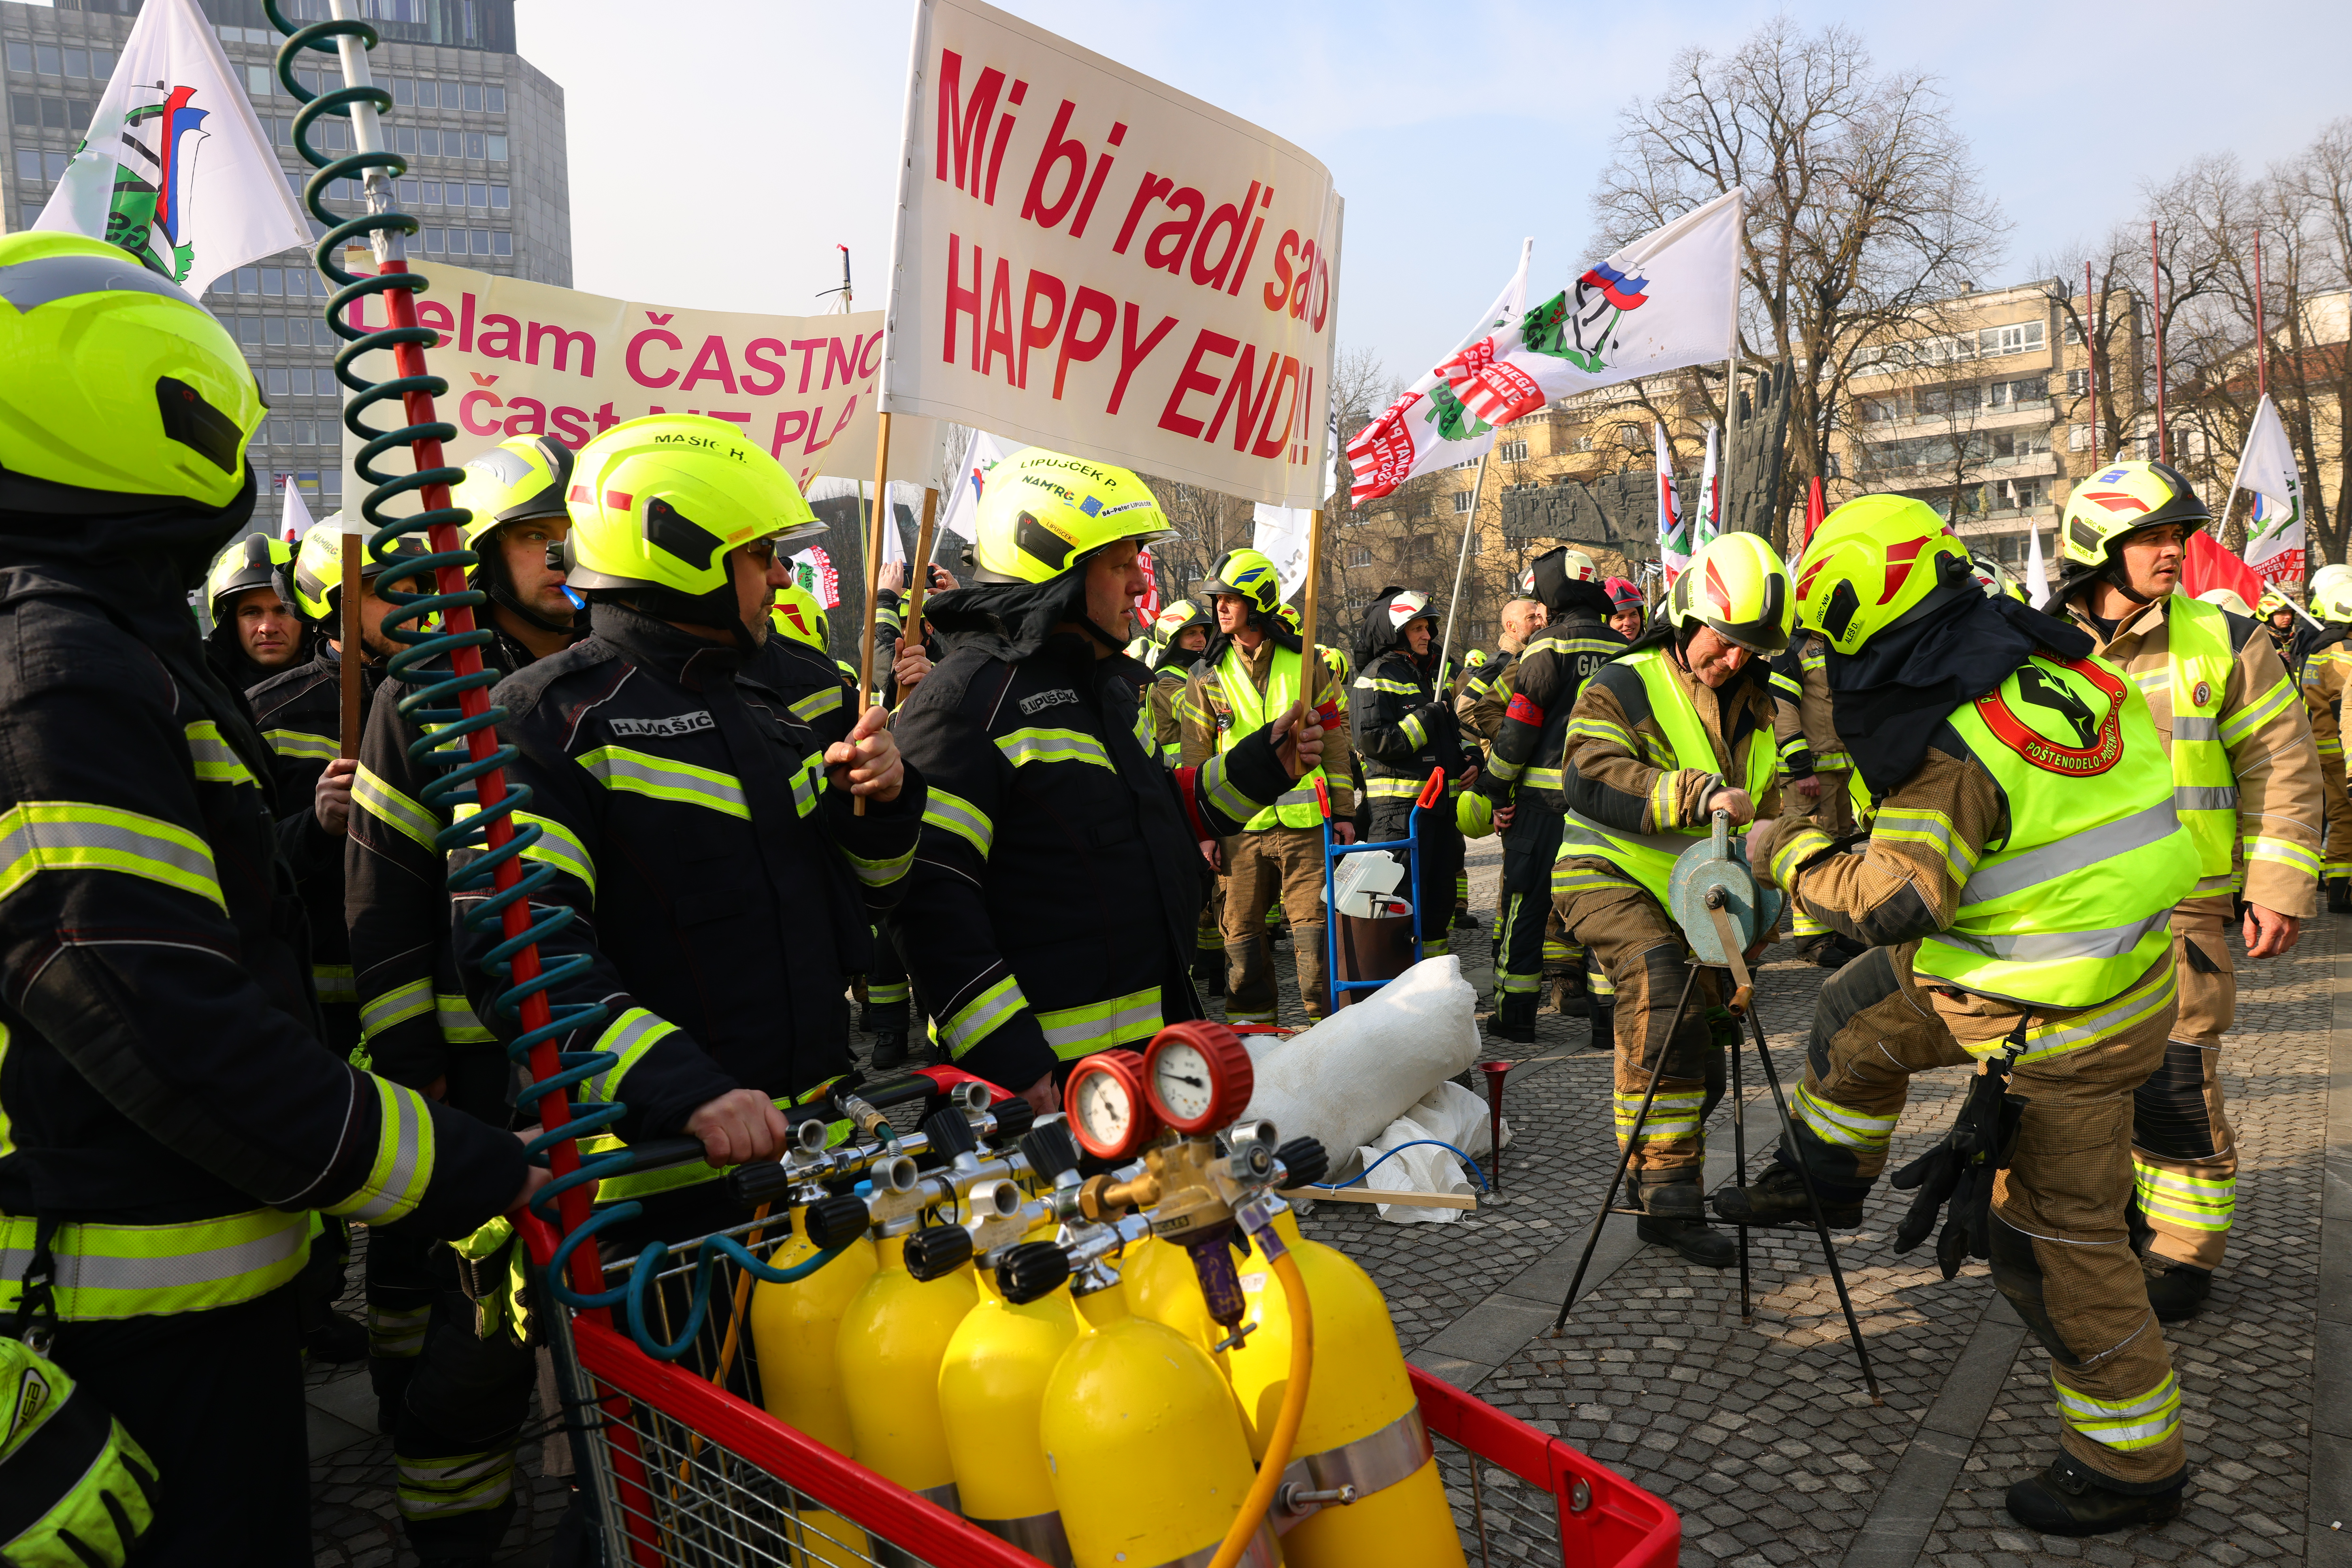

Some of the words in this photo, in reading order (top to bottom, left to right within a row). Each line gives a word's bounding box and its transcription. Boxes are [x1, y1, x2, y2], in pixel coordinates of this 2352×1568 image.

[936, 48, 1028, 206] Mi
[1020, 99, 1128, 239] bi
[1112, 179, 1274, 297] radi
[943, 233, 1179, 415] HAPPY
[626, 311, 883, 396] ČASTNO
[459, 372, 621, 451] čast
[771, 394, 858, 462] PLA
[729, 448, 747, 464] H.
[1105, 478, 1117, 491] P.
[2084, 518, 2097, 528] GRC
[311, 533, 339, 556] NAMIRG
[2071, 542, 2088, 557] DANIJEL
[1816, 607, 1825, 623] GRC
[1822, 594, 1830, 608] NM
[1845, 628, 1856, 645] ALEŠ
[614, 712, 713, 735] H.MAŠIĆ
